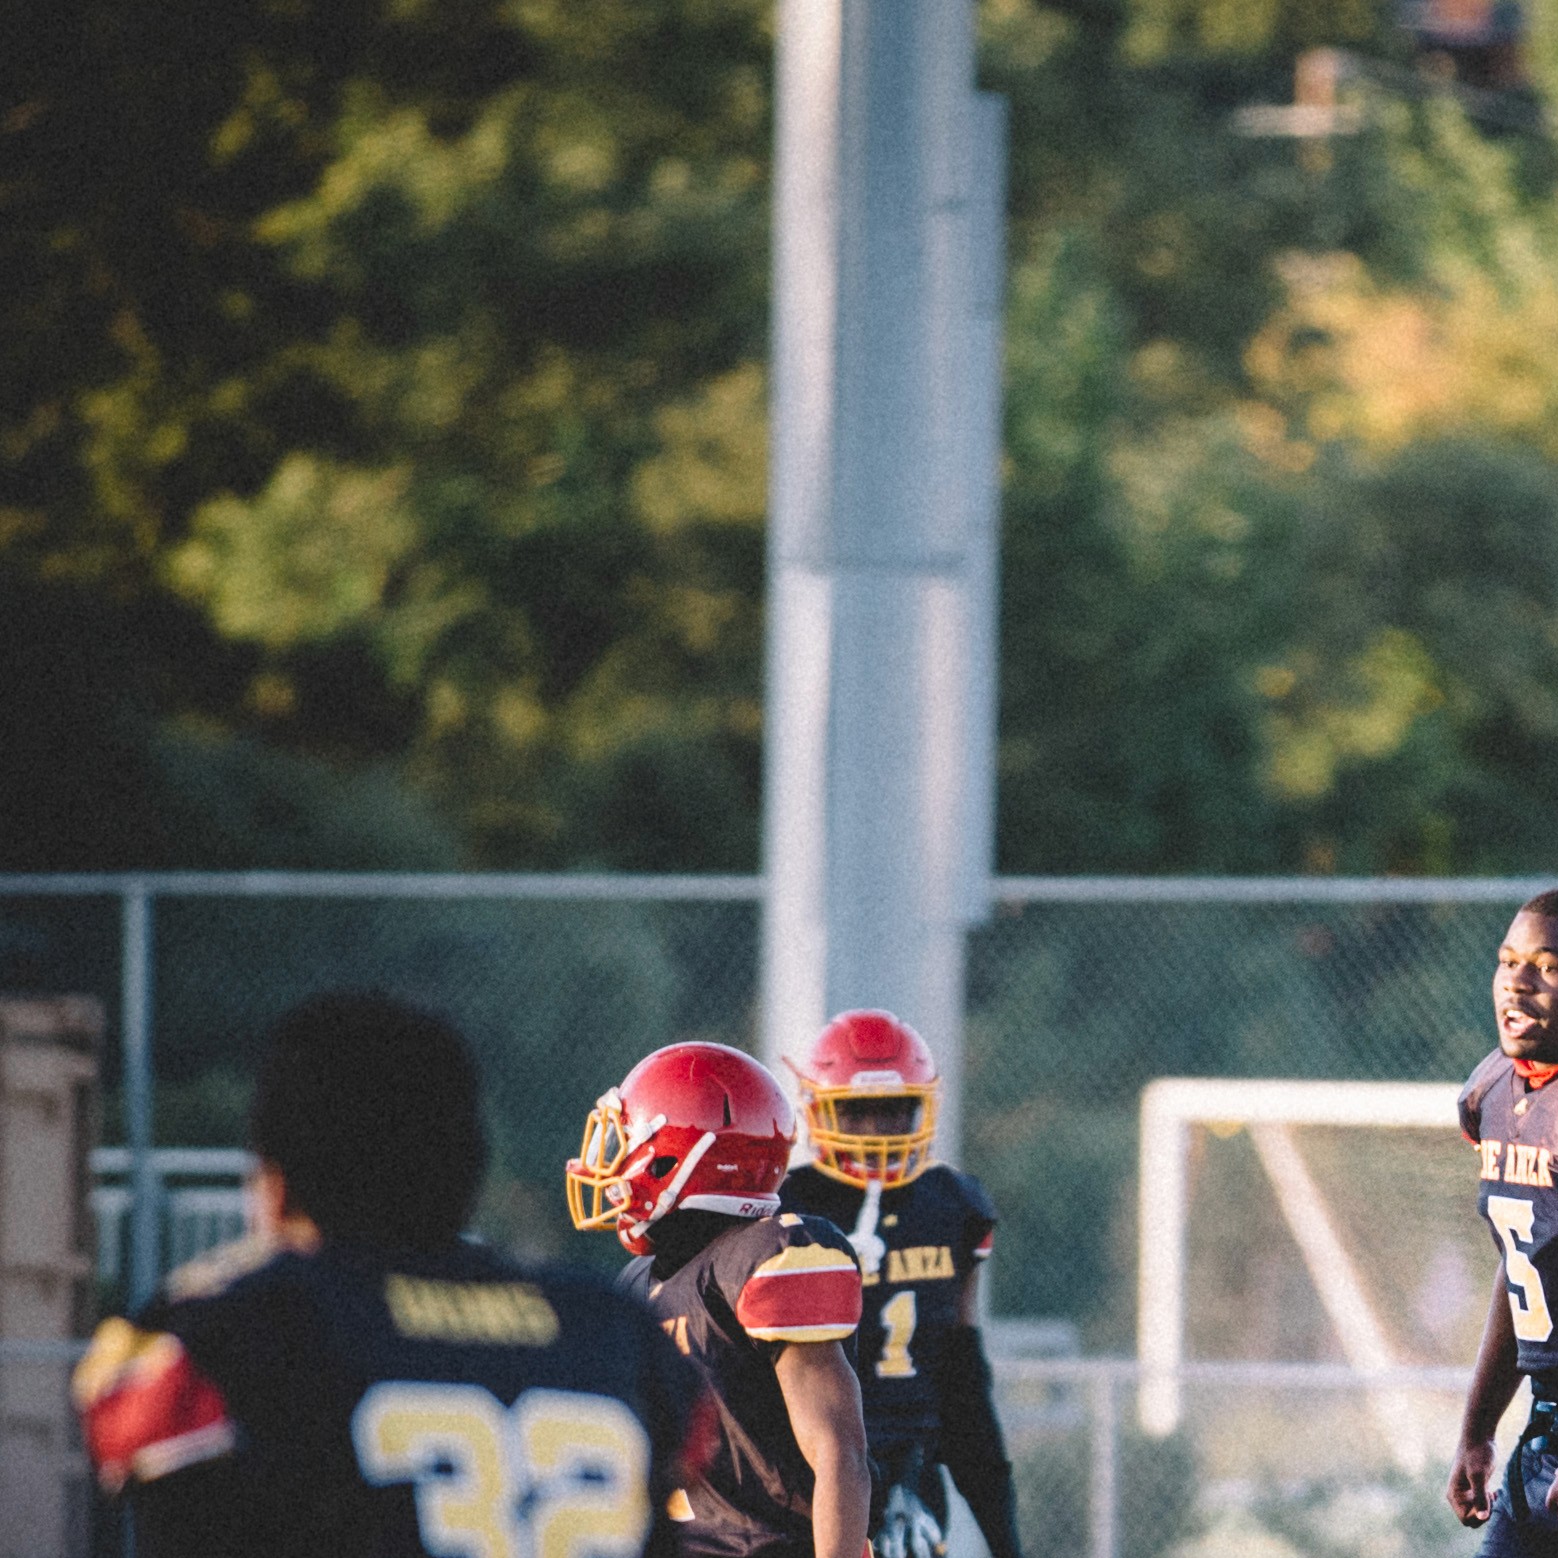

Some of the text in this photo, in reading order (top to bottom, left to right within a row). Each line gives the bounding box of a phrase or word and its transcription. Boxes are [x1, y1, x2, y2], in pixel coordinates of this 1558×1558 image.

[1504, 1143, 1553, 1187] ANZA
[1488, 1195, 1553, 1342] 5
[876, 1290, 917, 1377] 1
